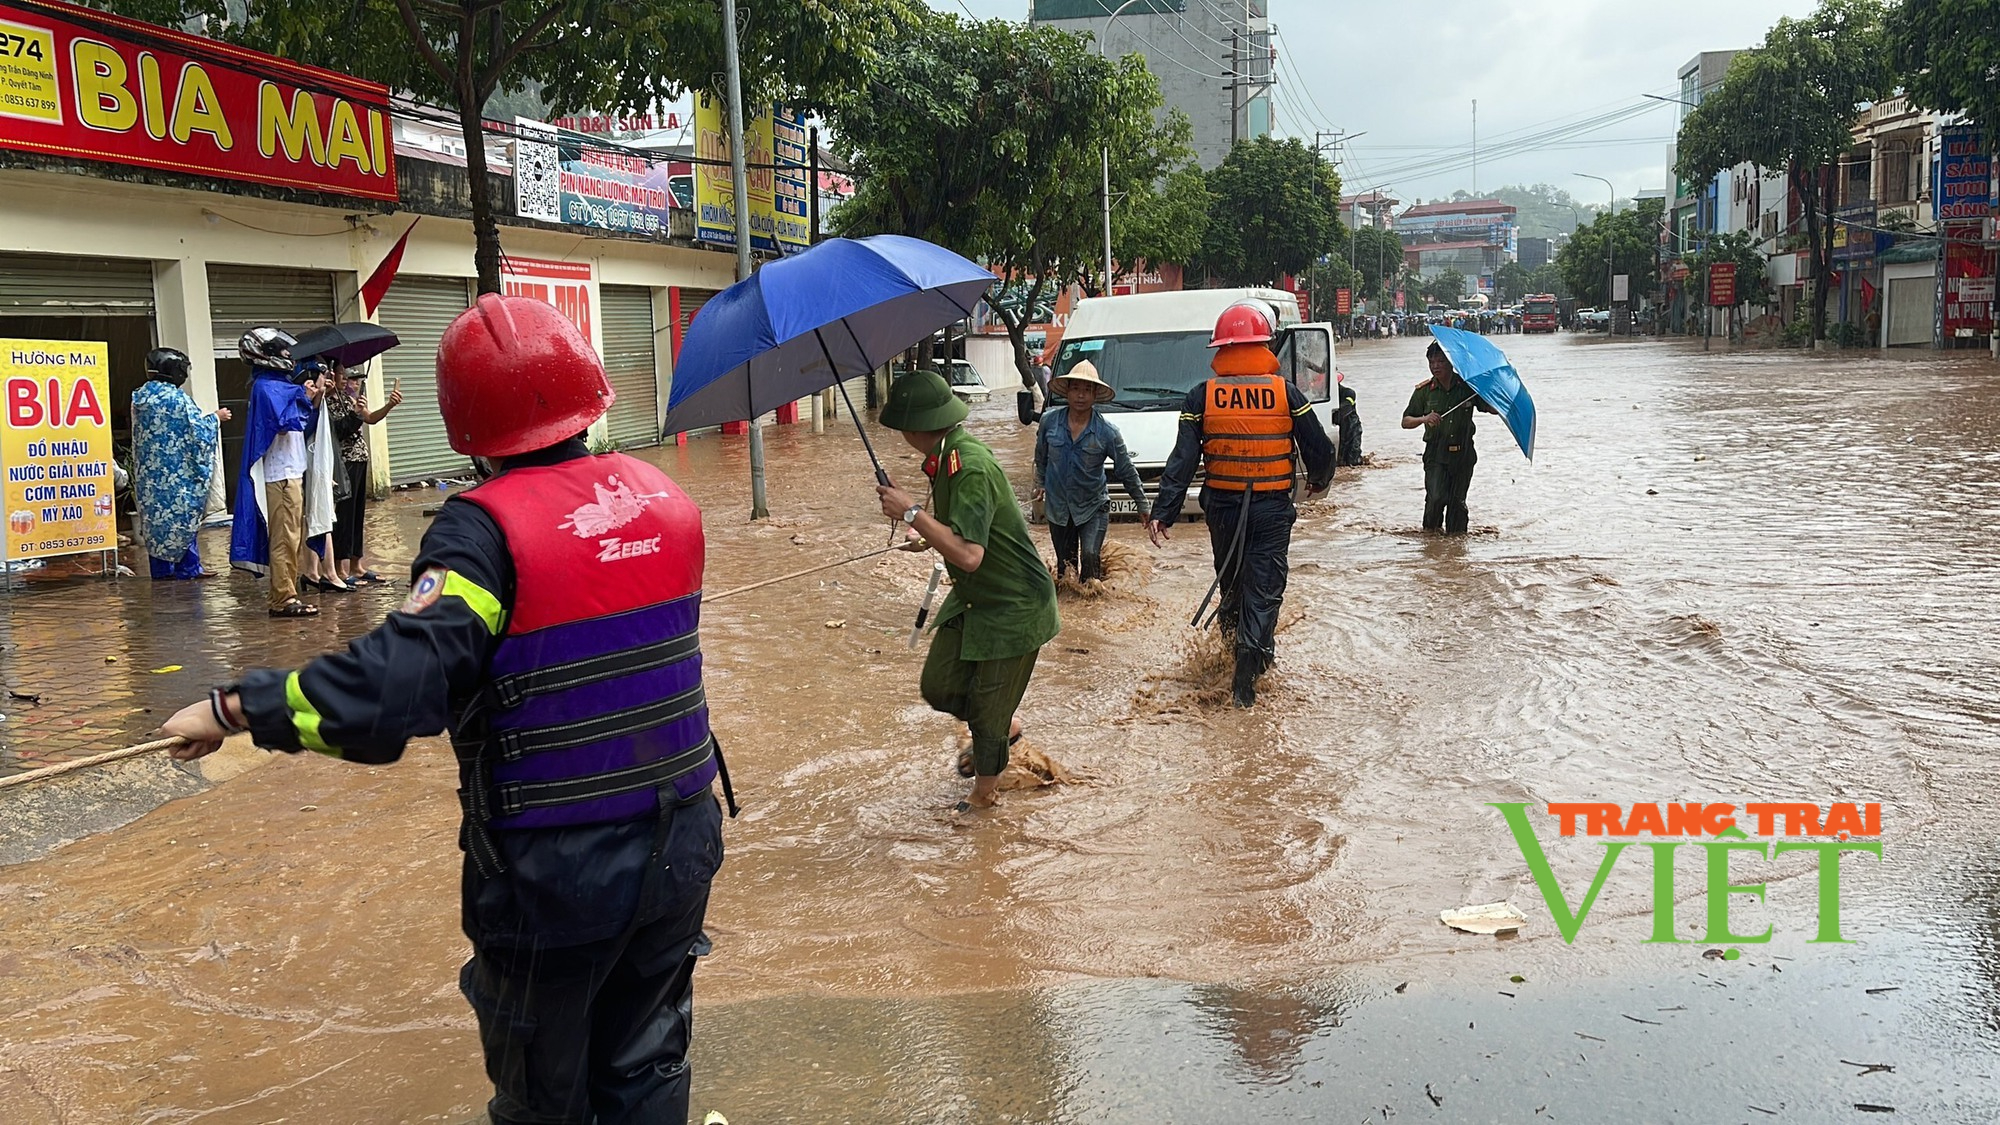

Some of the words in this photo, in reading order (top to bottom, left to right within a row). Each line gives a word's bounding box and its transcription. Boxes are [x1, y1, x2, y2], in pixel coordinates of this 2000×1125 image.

[9, 78, 27, 90] Quyết
[39, 70, 54, 80] Ninh
[4, 93, 24, 107] 0853
[25, 97, 40, 108] 637
[41, 99, 56, 111] 899
[70, 37, 234, 152] BIA
[258, 79, 387, 177] MAI
[1948, 136, 1979, 156] HẢ
[1945, 157, 1988, 178] SẢN
[560, 172, 576, 195] PIN
[577, 172, 602, 199] NĂNG
[568, 200, 592, 222] CTY
[591, 204, 608, 224] CS:
[608, 208, 628, 227] 0967
[629, 210, 645, 229] 652
[645, 213, 659, 231] 655
[1941, 199, 1990, 218] SỐNG
[1947, 300, 1960, 320] VÀ
[1963, 302, 1985, 321] PHỤ
[12, 351, 65, 365] HƯỜNG
[70, 353, 96, 365] MAI
[6, 376, 105, 428] BIA
[1214, 387, 1276, 410] CAND
[51, 438, 88, 458] NHẬU
[9, 464, 45, 481] NƯỚC
[48, 460, 73, 479] GIẢI
[77, 460, 107, 478] KHÁT
[25, 485, 56, 501] CƠM
[60, 483, 96, 499] RANG
[21, 543, 38, 553] ĐT:
[39, 539, 65, 551] 0853
[66, 537, 85, 548] 637
[86, 535, 105, 545] 899
[595, 535, 662, 563] ZEBEC
